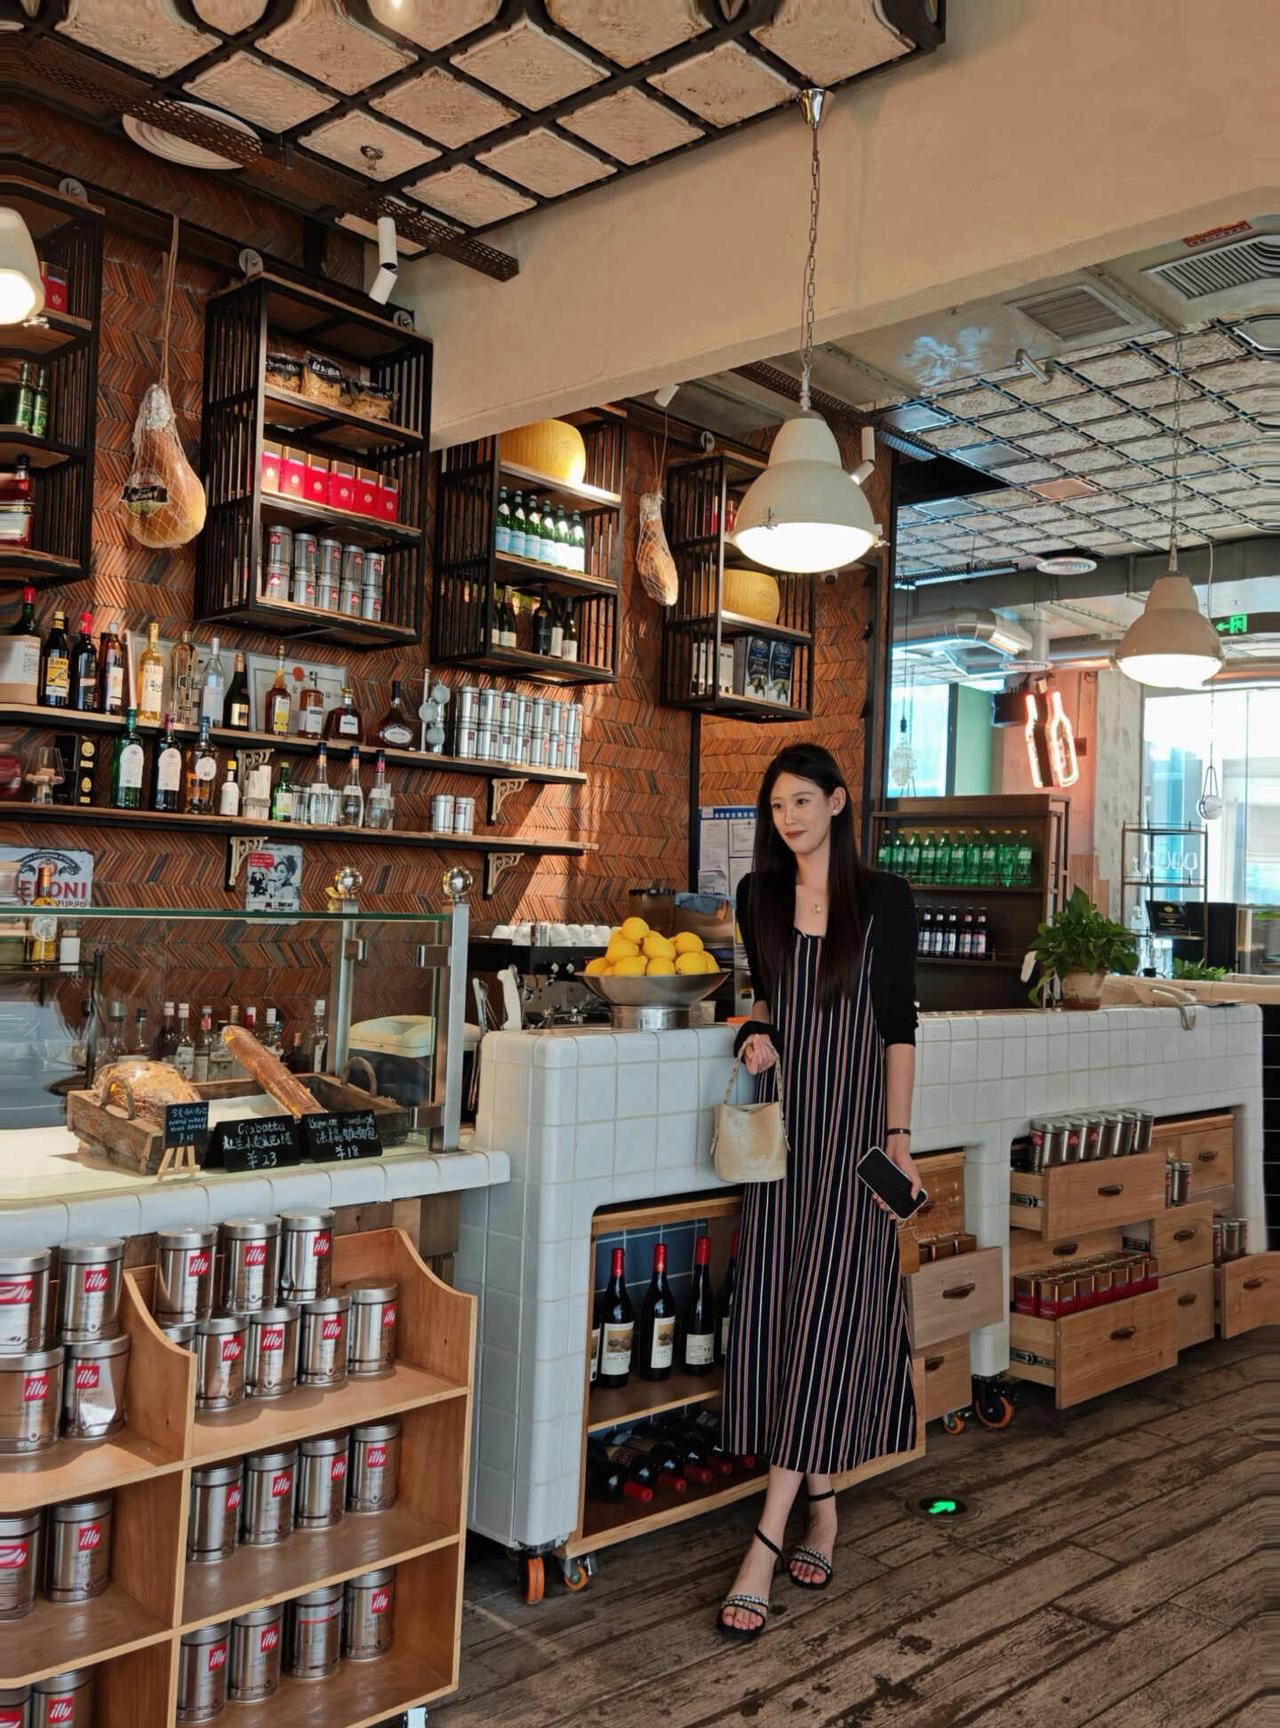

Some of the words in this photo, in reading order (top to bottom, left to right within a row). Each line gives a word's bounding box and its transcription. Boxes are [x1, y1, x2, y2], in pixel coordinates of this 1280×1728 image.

[314, 1237, 330, 1252] illy
[246, 1247, 266, 1264] illy
[190, 1256, 208, 1273] illy
[86, 1272, 107, 1290] illy
[383, 1309, 396, 1324] illy
[323, 1320, 341, 1336] illy
[263, 1330, 283, 1347] illy
[223, 1340, 241, 1358] illy
[76, 1368, 98, 1386] illy
[26, 1379, 47, 1398] illy
[368, 1448, 386, 1465] illy
[331, 1461, 345, 1478] illy
[273, 1477, 291, 1494] illy
[80, 1530, 100, 1547] illy
[372, 1592, 388, 1609] illy
[261, 1630, 278, 1648] illy
[209, 1648, 226, 1667] illy
[50, 1702, 72, 1720] illy
